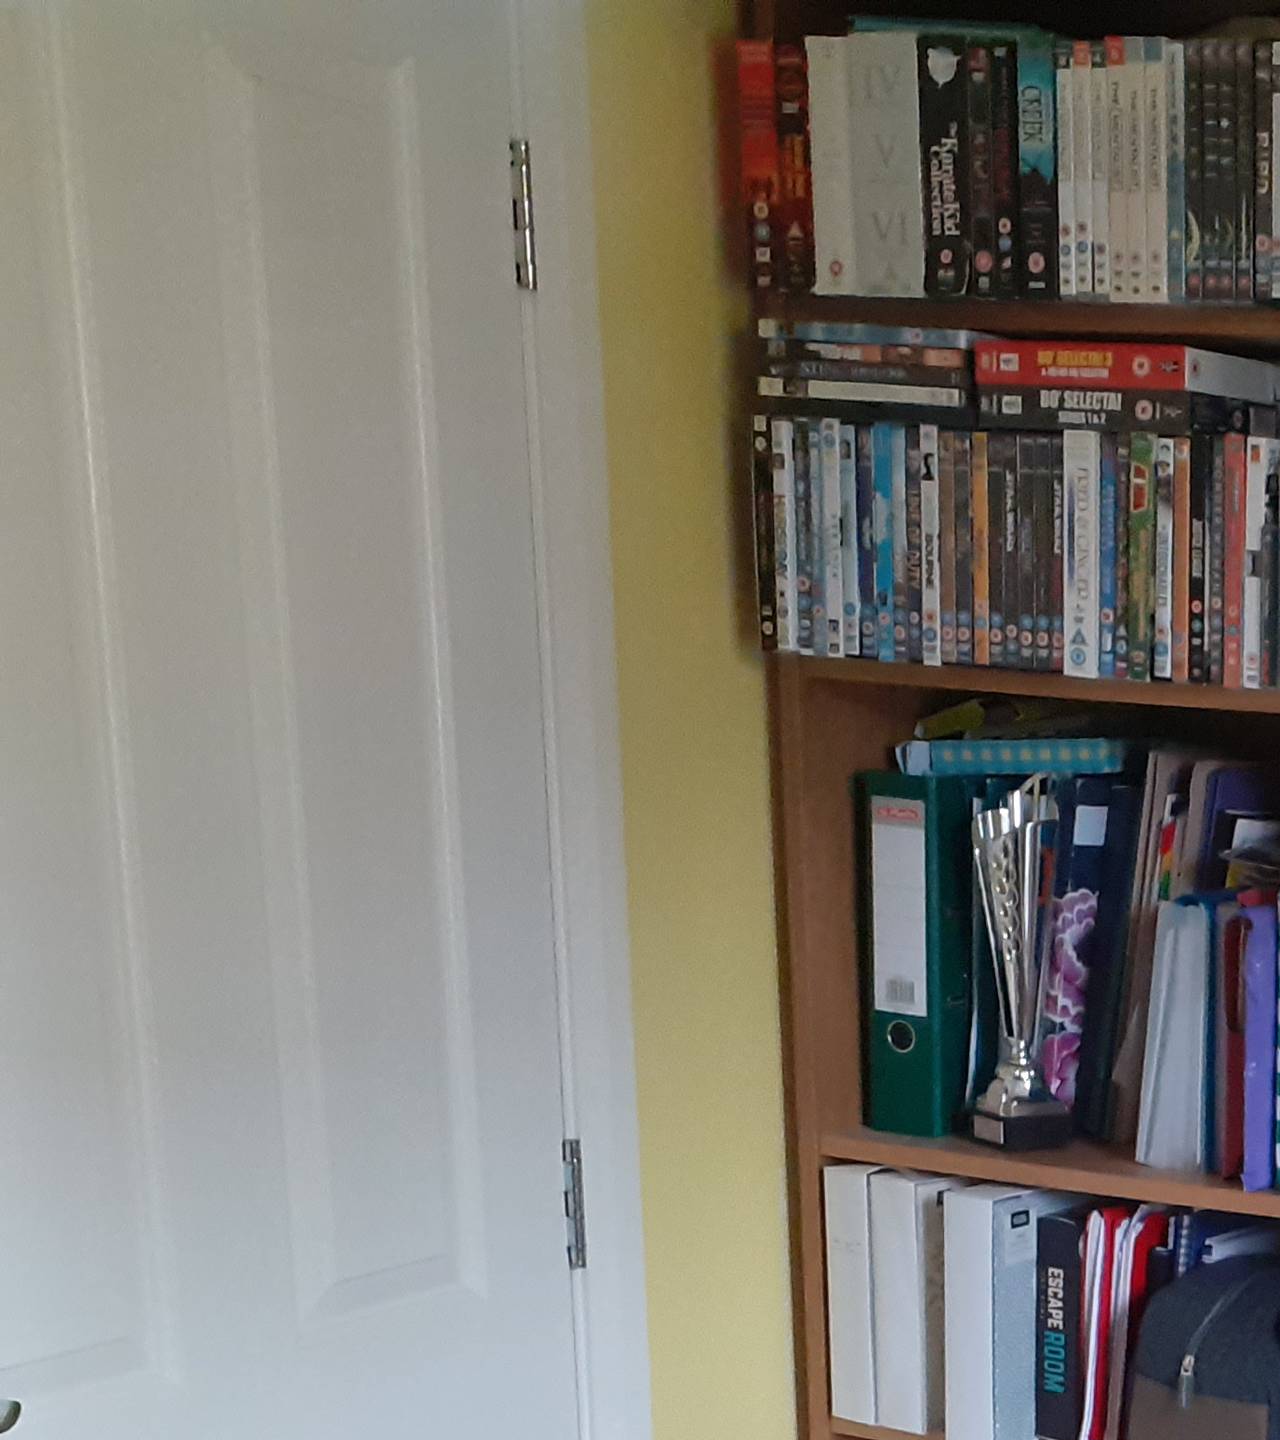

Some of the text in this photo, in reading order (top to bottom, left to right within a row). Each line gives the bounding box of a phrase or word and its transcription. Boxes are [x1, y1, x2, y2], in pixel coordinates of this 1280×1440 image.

[943, 202, 961, 236] Kid
[924, 533, 936, 590] BOURNE
[1044, 1267, 1067, 1393] ESCAPE ROOM
